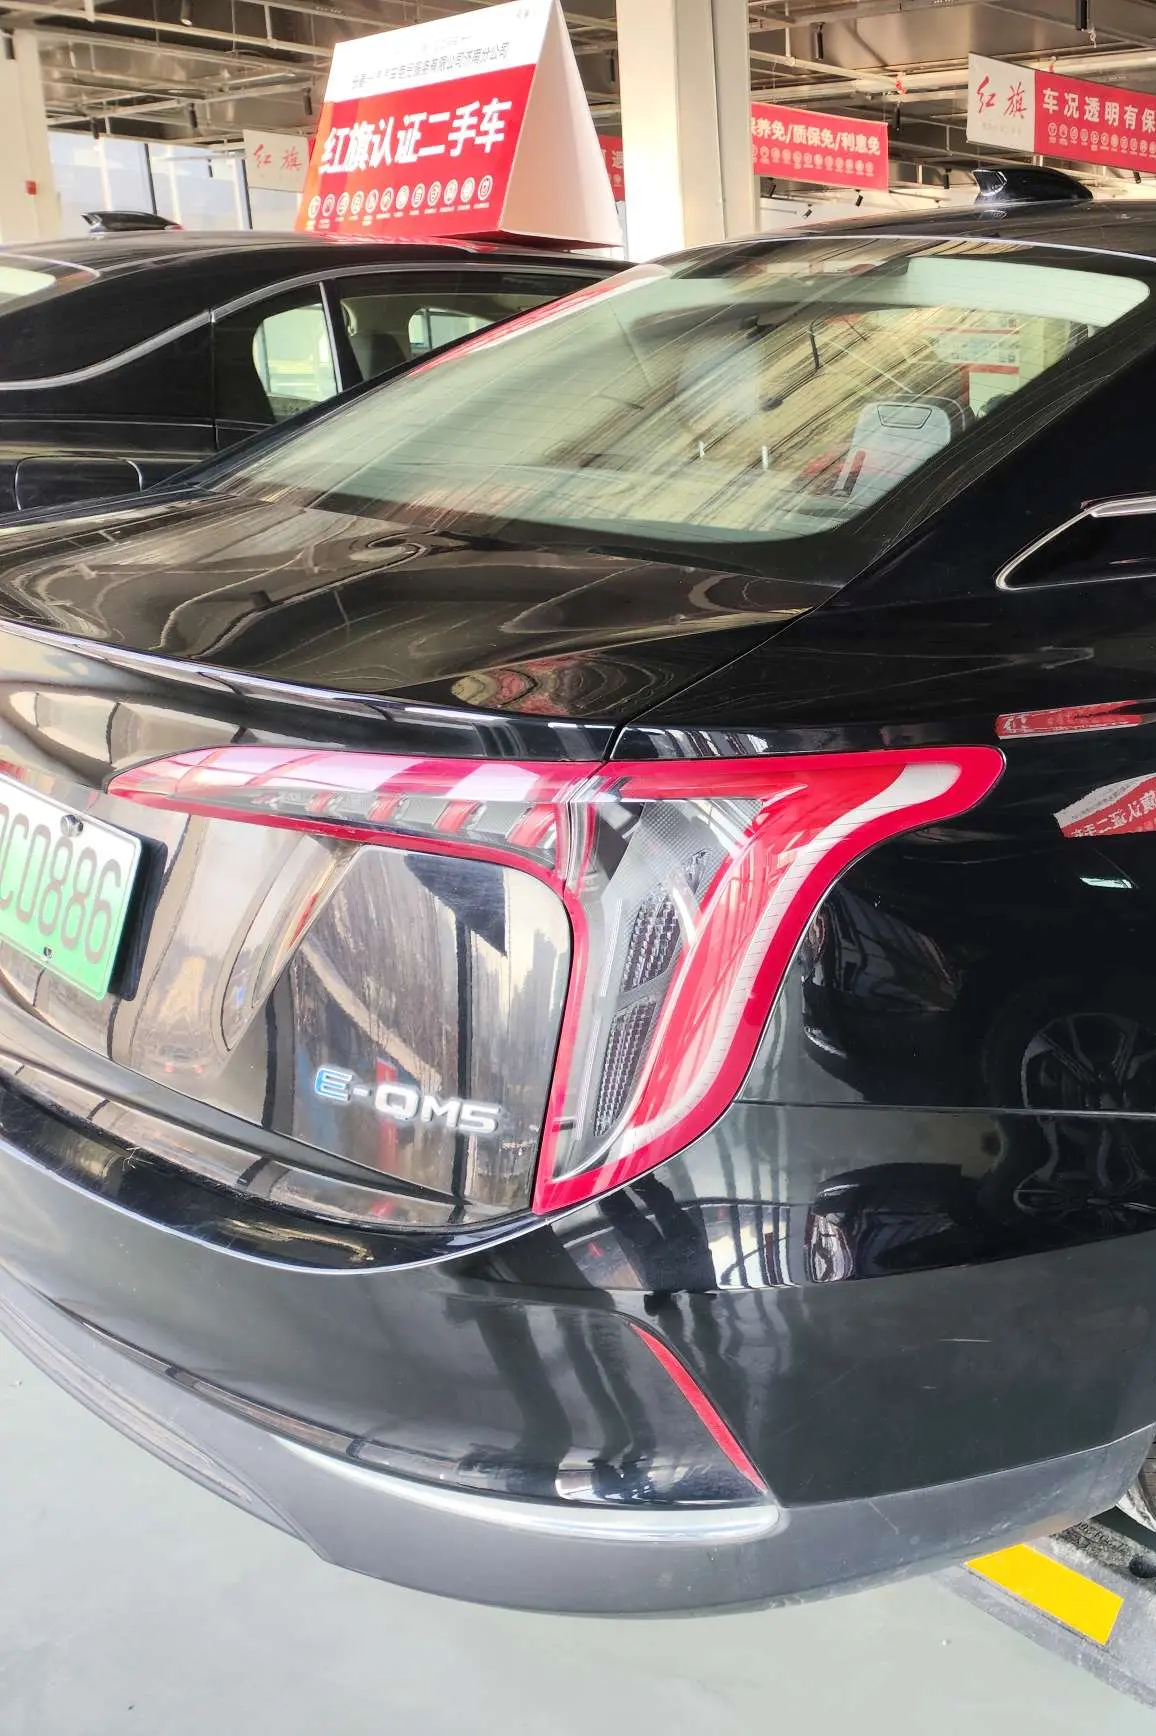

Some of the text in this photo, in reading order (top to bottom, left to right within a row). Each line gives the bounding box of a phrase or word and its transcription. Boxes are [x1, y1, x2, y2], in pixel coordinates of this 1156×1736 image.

[976, 75, 1028, 120] 红旗
[317, 97, 513, 176] 红旗认证二手车
[314, 1065, 502, 1134] E-QM5
